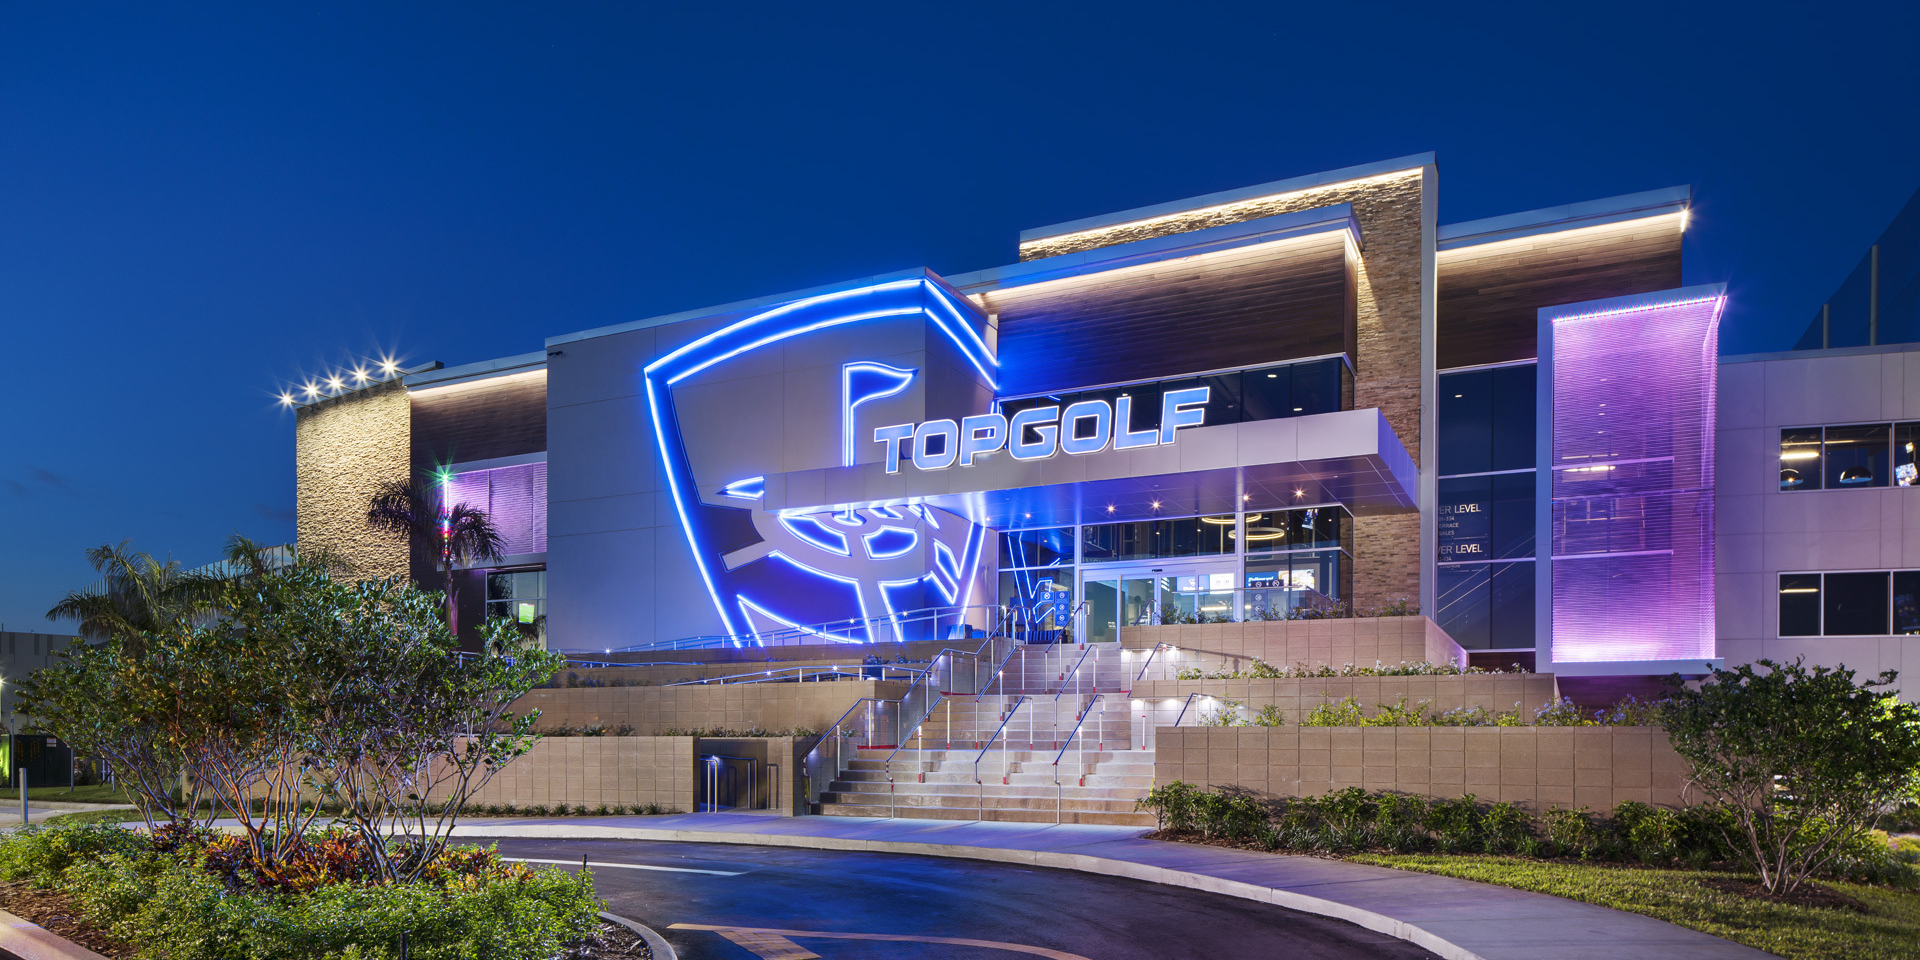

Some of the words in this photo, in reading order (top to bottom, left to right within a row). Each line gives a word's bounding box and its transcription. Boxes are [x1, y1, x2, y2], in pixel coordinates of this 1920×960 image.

[873, 386, 1210, 474] TOPGOLF
[1454, 504, 1481, 513] LEVEL
[1455, 544, 1482, 553] LEVEL
